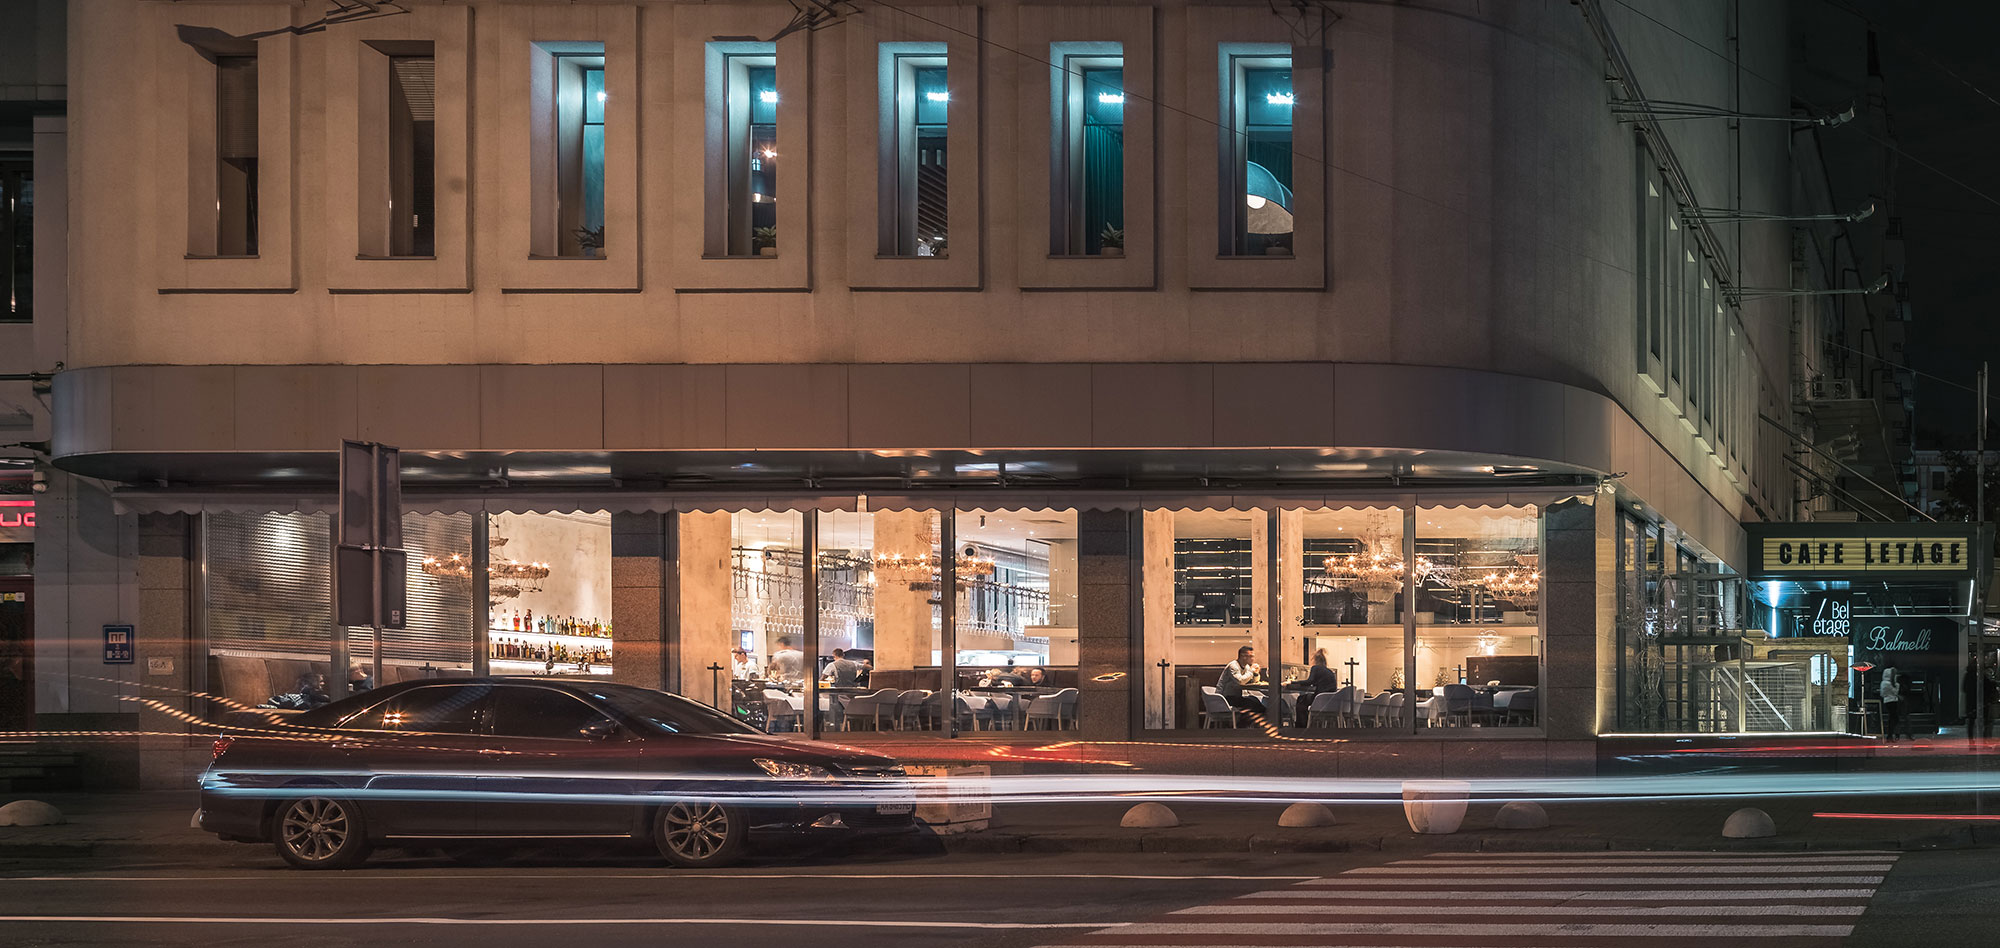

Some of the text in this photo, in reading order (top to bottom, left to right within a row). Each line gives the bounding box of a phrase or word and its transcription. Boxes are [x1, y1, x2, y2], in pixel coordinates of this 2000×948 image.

[1779, 542, 1961, 565] CAFE LETAGE
[1831, 600, 1850, 619] Bel
[1866, 626, 1931, 651] Balmelli
